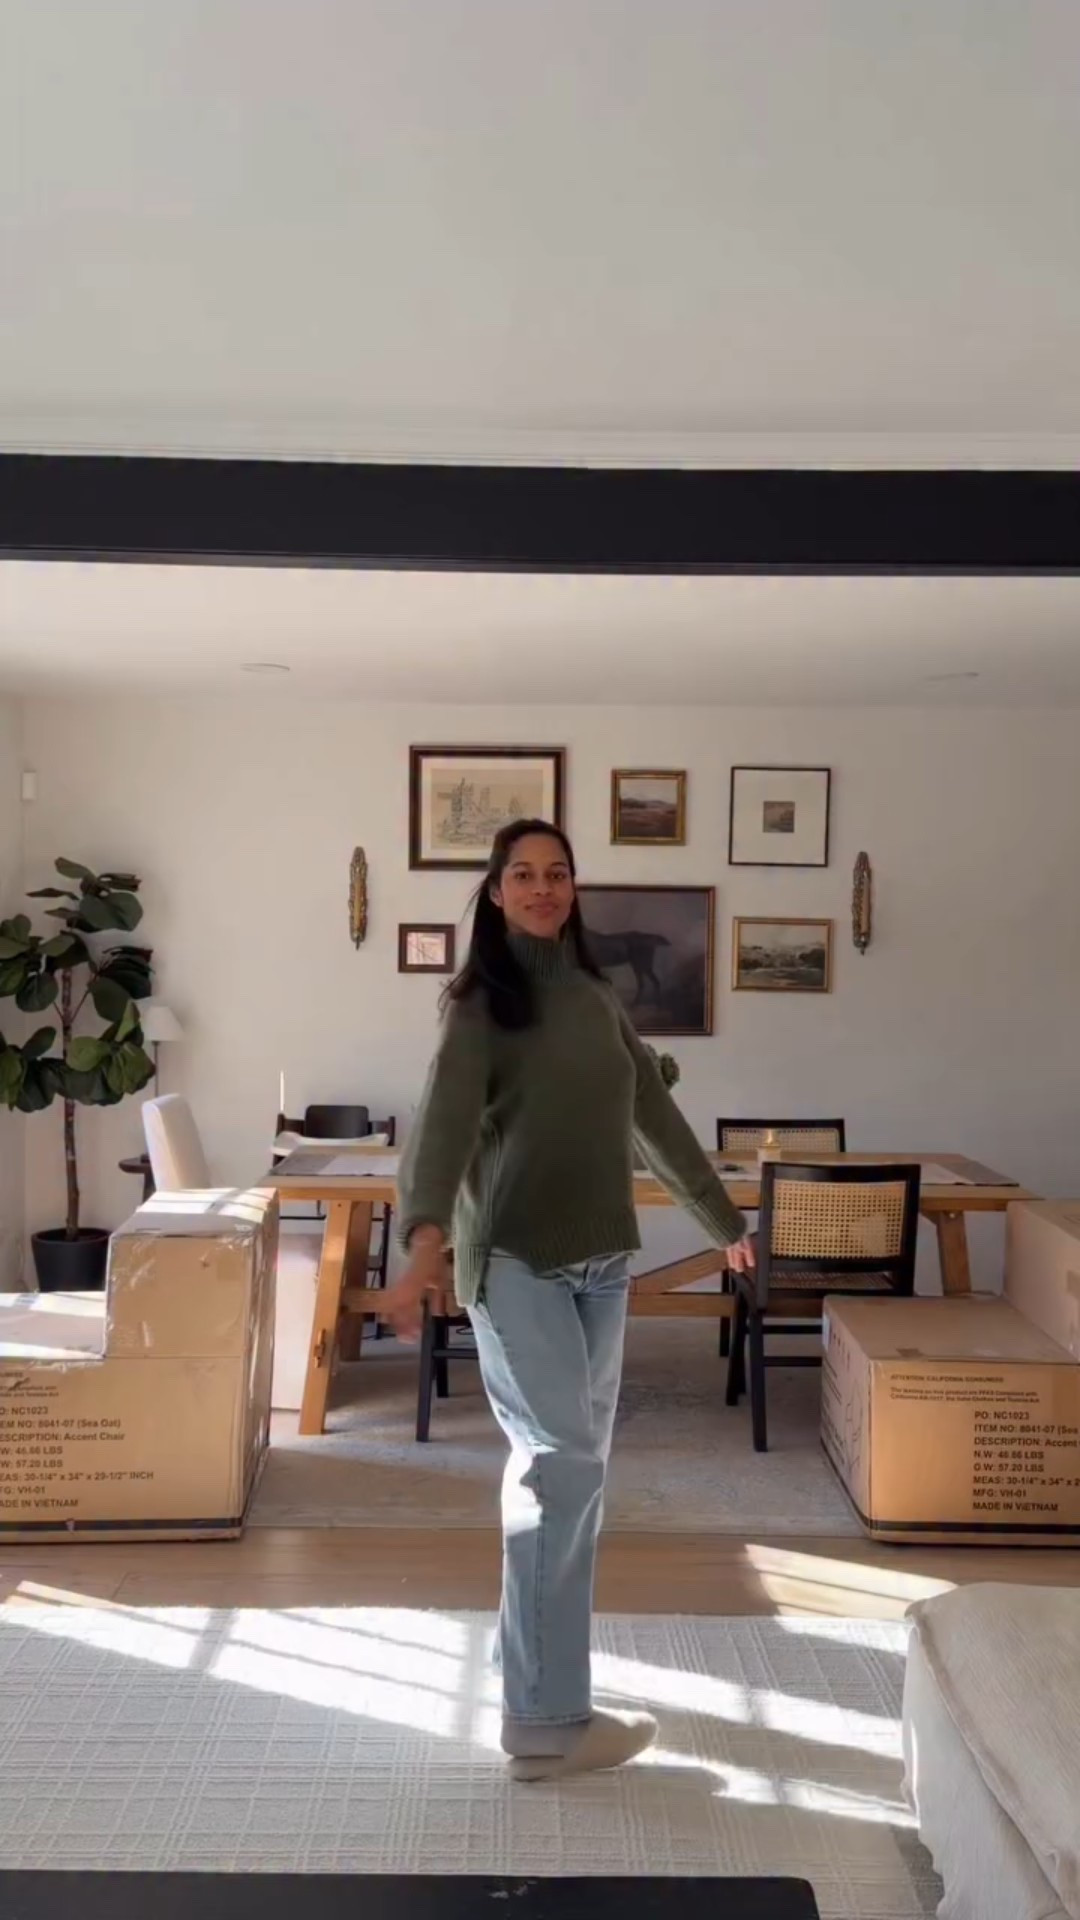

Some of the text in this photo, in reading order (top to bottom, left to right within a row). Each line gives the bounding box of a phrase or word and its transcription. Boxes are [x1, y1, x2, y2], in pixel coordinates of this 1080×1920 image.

[974, 1424, 997, 1433] ITEM
[64, 1433, 97, 1441] Accent
[21, 1499, 31, 1507] IN
[33, 1499, 79, 1507] VIETNAM
[973, 1501, 1059, 1511] MADE IN VIETNAM
